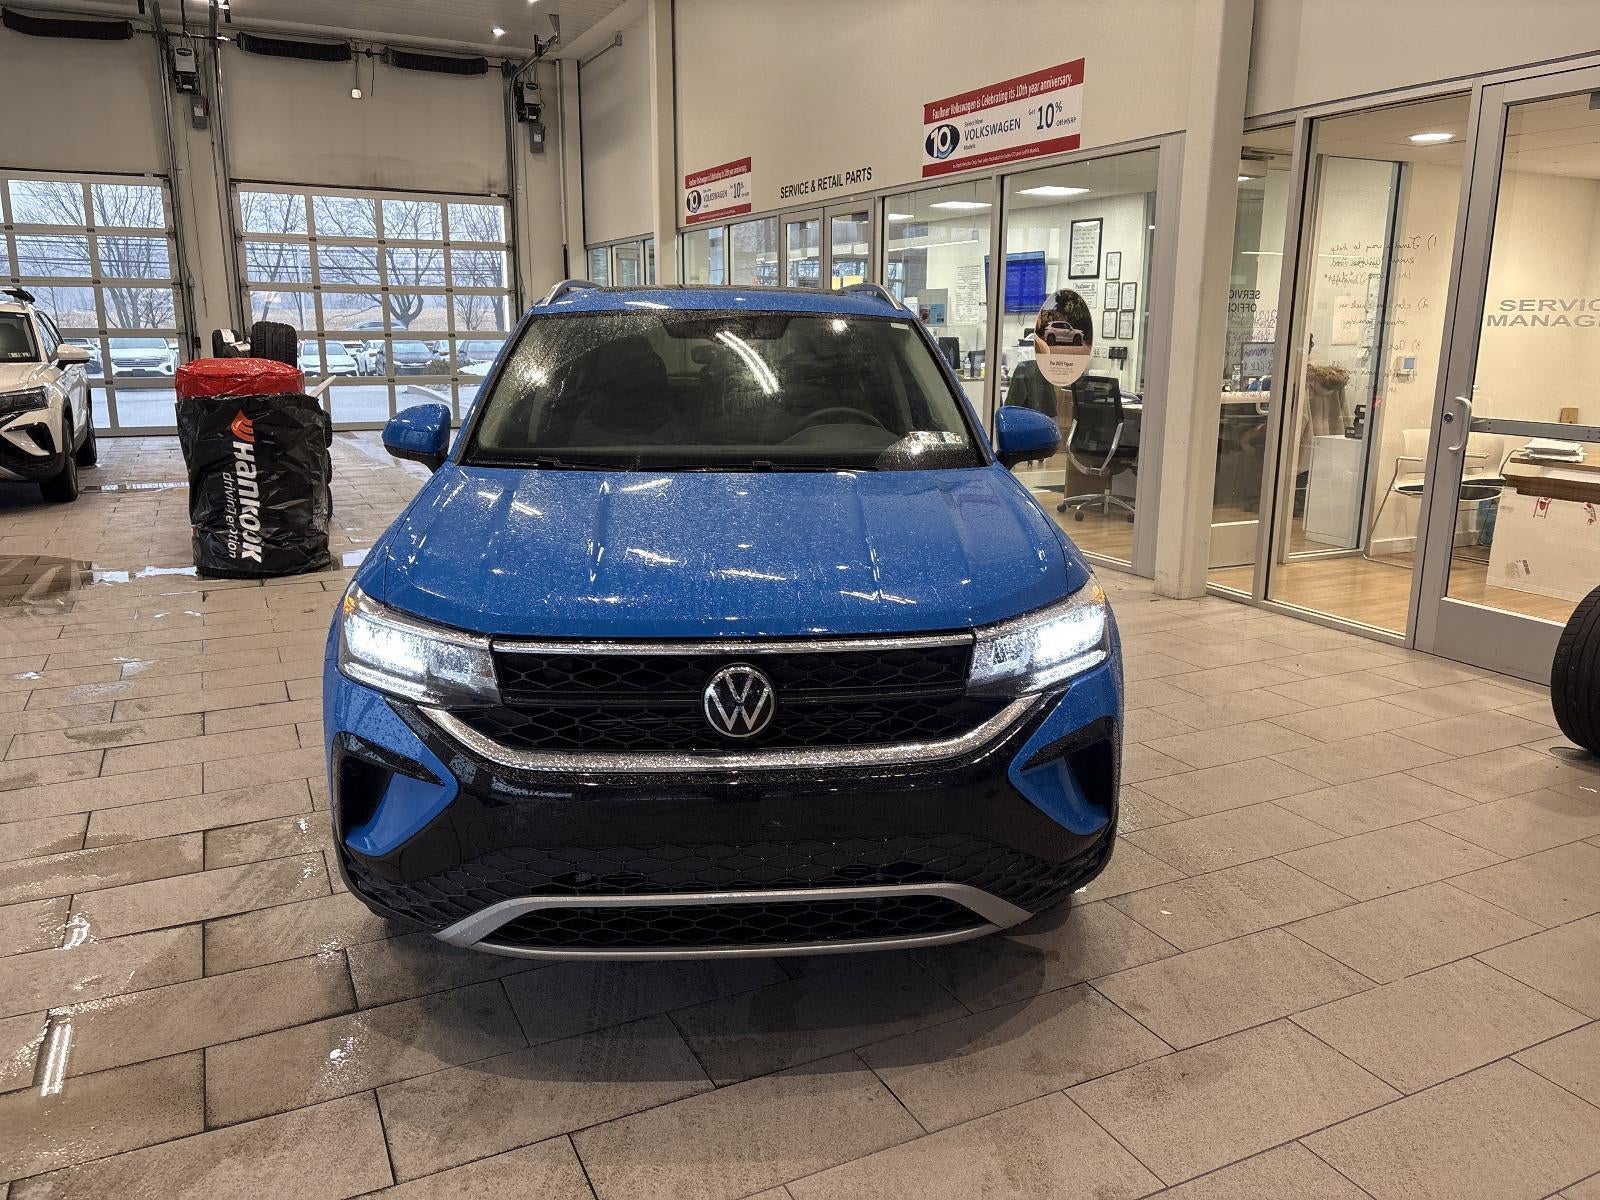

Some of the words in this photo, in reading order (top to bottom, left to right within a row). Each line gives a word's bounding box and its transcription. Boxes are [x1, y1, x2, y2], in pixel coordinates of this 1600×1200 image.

[981, 89, 1009, 107] Celebrating
[1015, 82, 1028, 98] 10th
[963, 117, 1021, 142] VOLKSWAGEN
[780, 180, 809, 199] SERVICE
[810, 180, 816, 191] &
[817, 173, 844, 191] RETAIL
[845, 166, 873, 186] PARTS
[1486, 314, 1600, 328] MANAG
[222, 471, 237, 514] driving
[231, 441, 263, 564] Hankook
